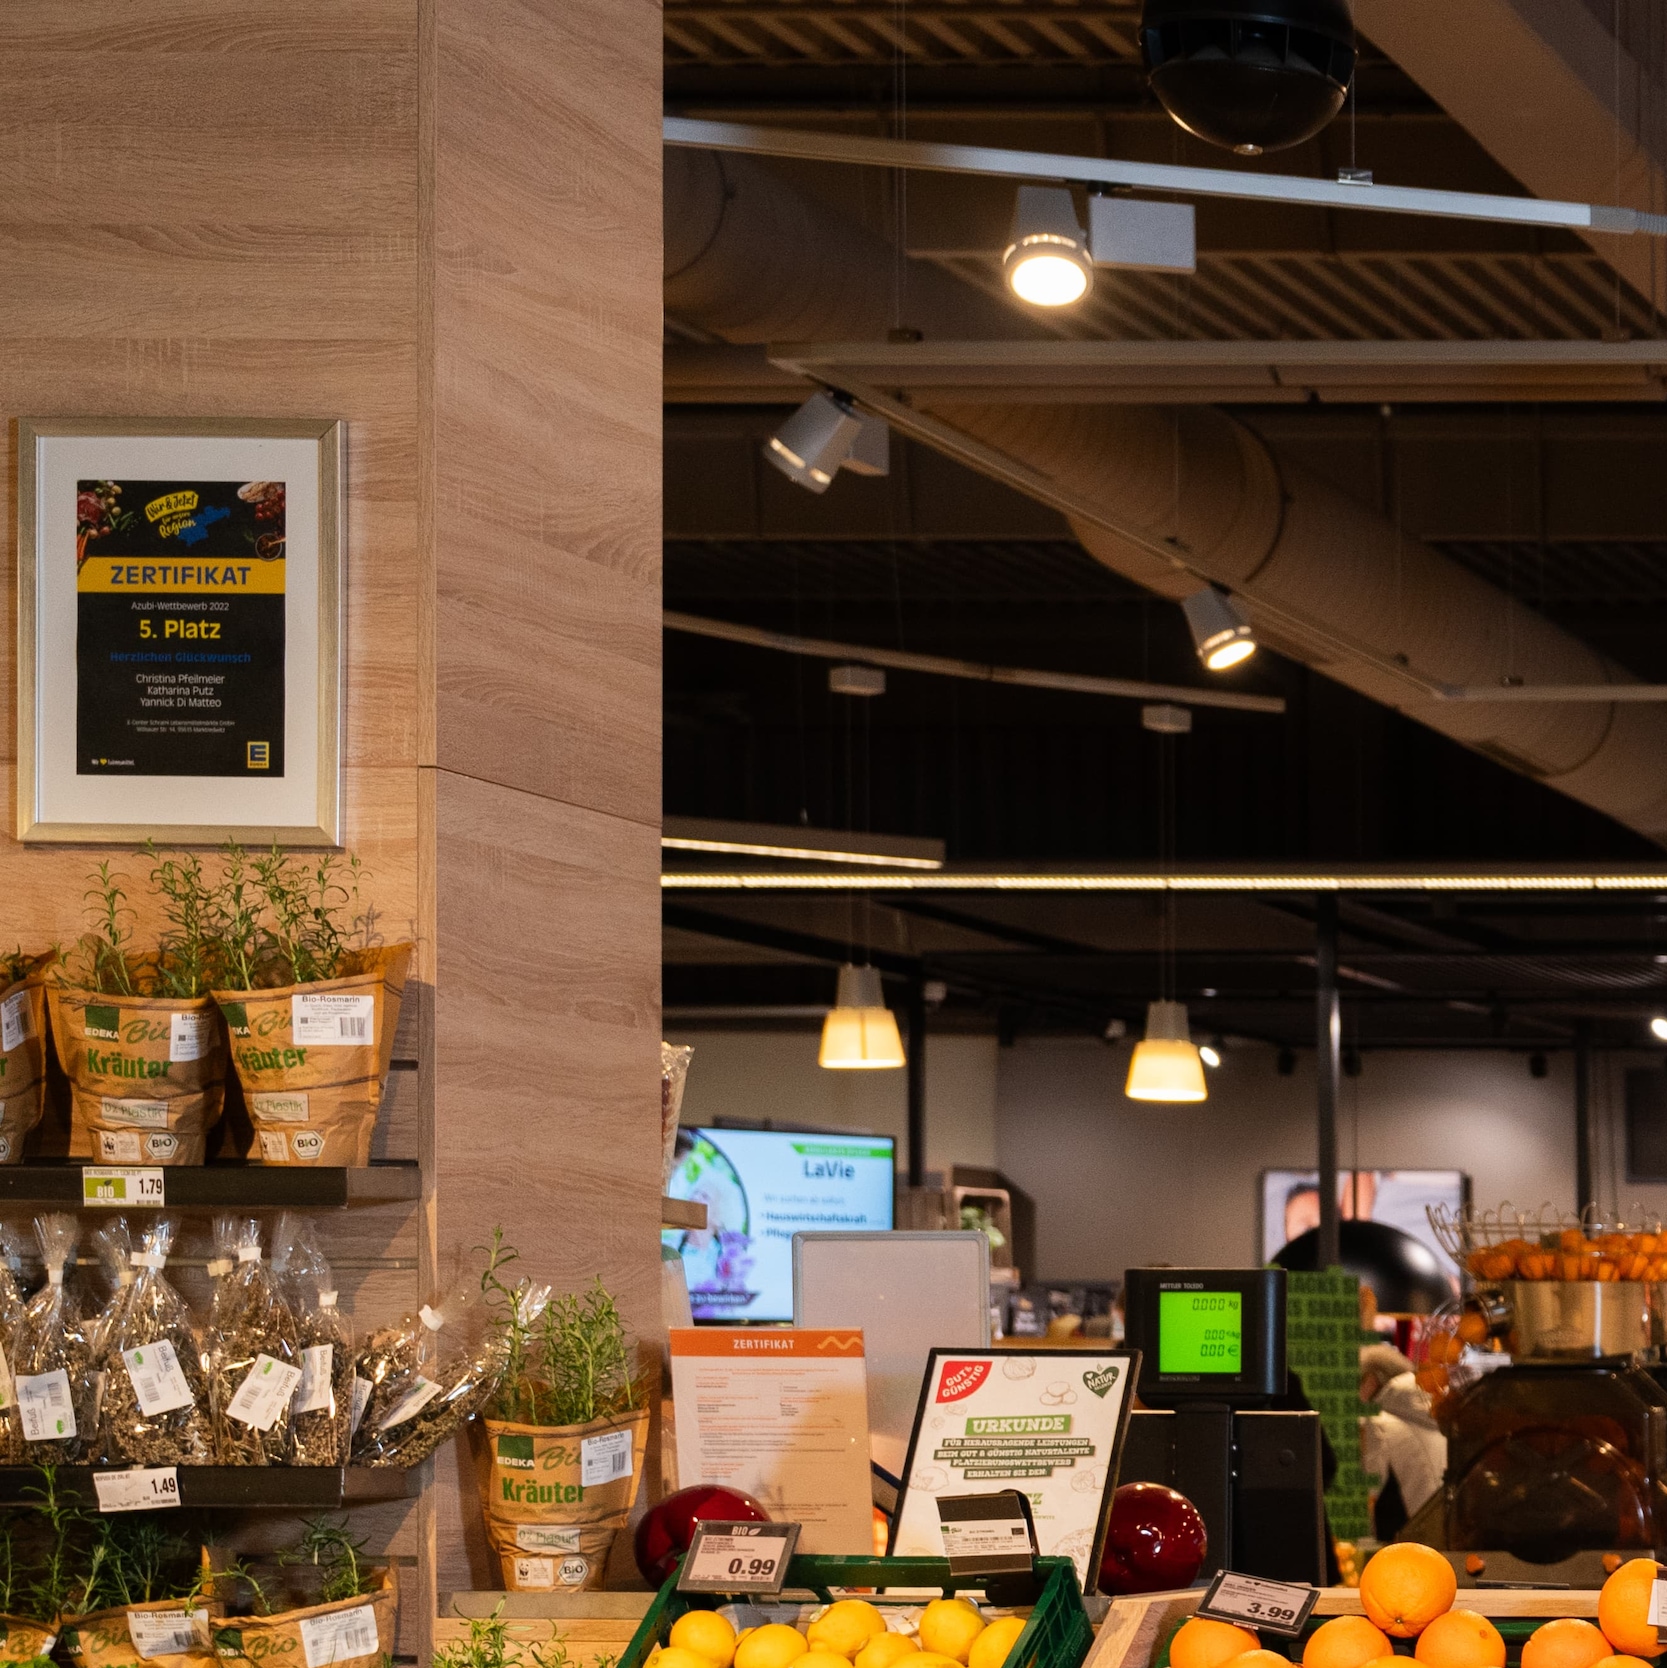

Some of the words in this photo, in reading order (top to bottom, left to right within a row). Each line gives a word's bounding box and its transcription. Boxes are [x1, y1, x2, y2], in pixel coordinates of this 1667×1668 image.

[111, 566, 251, 584] ZERTIFIKAT
[131, 602, 207, 611] Azubi-Wettbewerb
[210, 603, 229, 611] 2022
[140, 620, 157, 638] 5.
[165, 620, 221, 639] Platz
[110, 652, 171, 662] Herzlichen
[176, 652, 250, 663] Glückwunsch
[136, 674, 176, 684] Christina
[178, 674, 225, 684] Pfeilmeier
[148, 686, 190, 695] Katharina
[193, 687, 213, 696] Putz
[140, 698, 174, 707] Yannick
[177, 698, 186, 707] Di
[189, 699, 221, 707] Matteo
[302, 995, 360, 1003] Bio-Rosmarin
[87, 1048, 172, 1079] Kräuter
[804, 1160, 855, 1178] LaVie
[138, 1179, 162, 1195] 1.79
[732, 1338, 795, 1351] ZERTIFIKAT
[1087, 1372, 1116, 1389] NATUR
[973, 1417, 1064, 1433] URKUNDE
[988, 1448, 1022, 1457] GÜNSTIG
[1025, 1447, 1090, 1456] NATURTALENTE
[953, 1459, 1072, 1467] PLATZIERUNGSWETTBEWERB
[151, 1478, 176, 1494] 1.49
[502, 1477, 584, 1503] Kräuter
[732, 1526, 748, 1535] BIO
[728, 1558, 775, 1575] 0.99
[1247, 1602, 1295, 1621] 3.99
